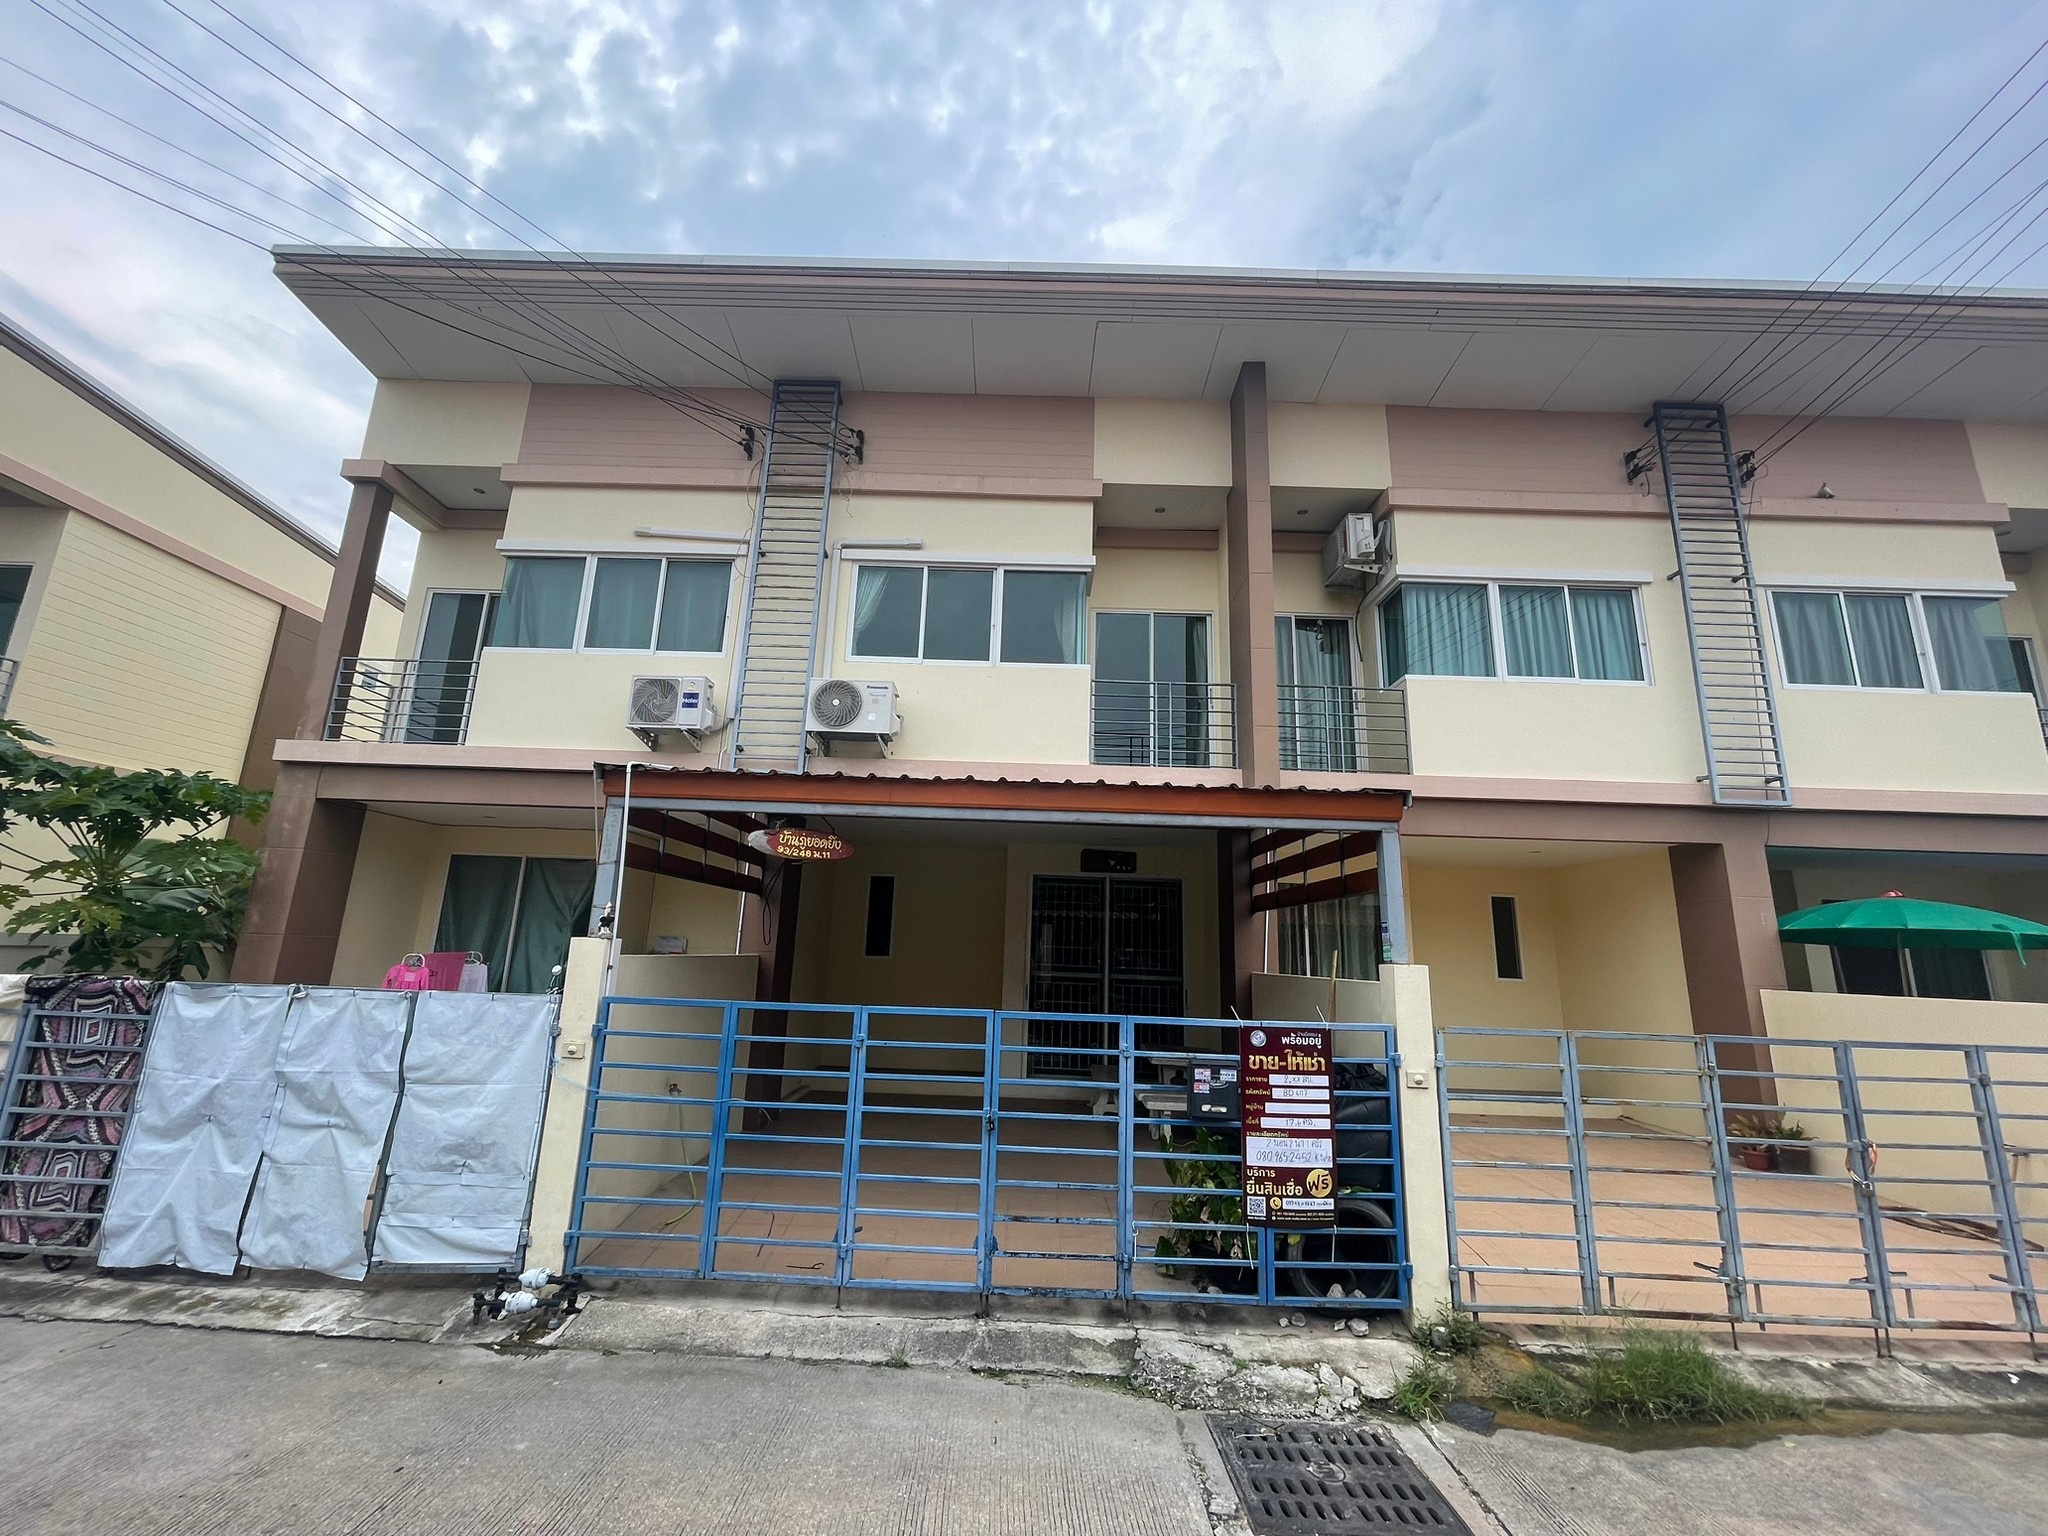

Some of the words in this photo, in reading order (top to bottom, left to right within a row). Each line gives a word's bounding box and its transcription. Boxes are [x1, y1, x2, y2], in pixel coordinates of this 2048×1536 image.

[777, 845, 812, 858] 93/248
[1281, 1032, 1322, 1049] พร้อมอยู่
[1248, 1049, 1326, 1072] ขาย-ให้เช่า
[1246, 1167, 1276, 1178] บริการ
[1308, 1169, 1330, 1192] ฟรี
[1246, 1177, 1303, 1196] ยื่นสินเชื่อ
